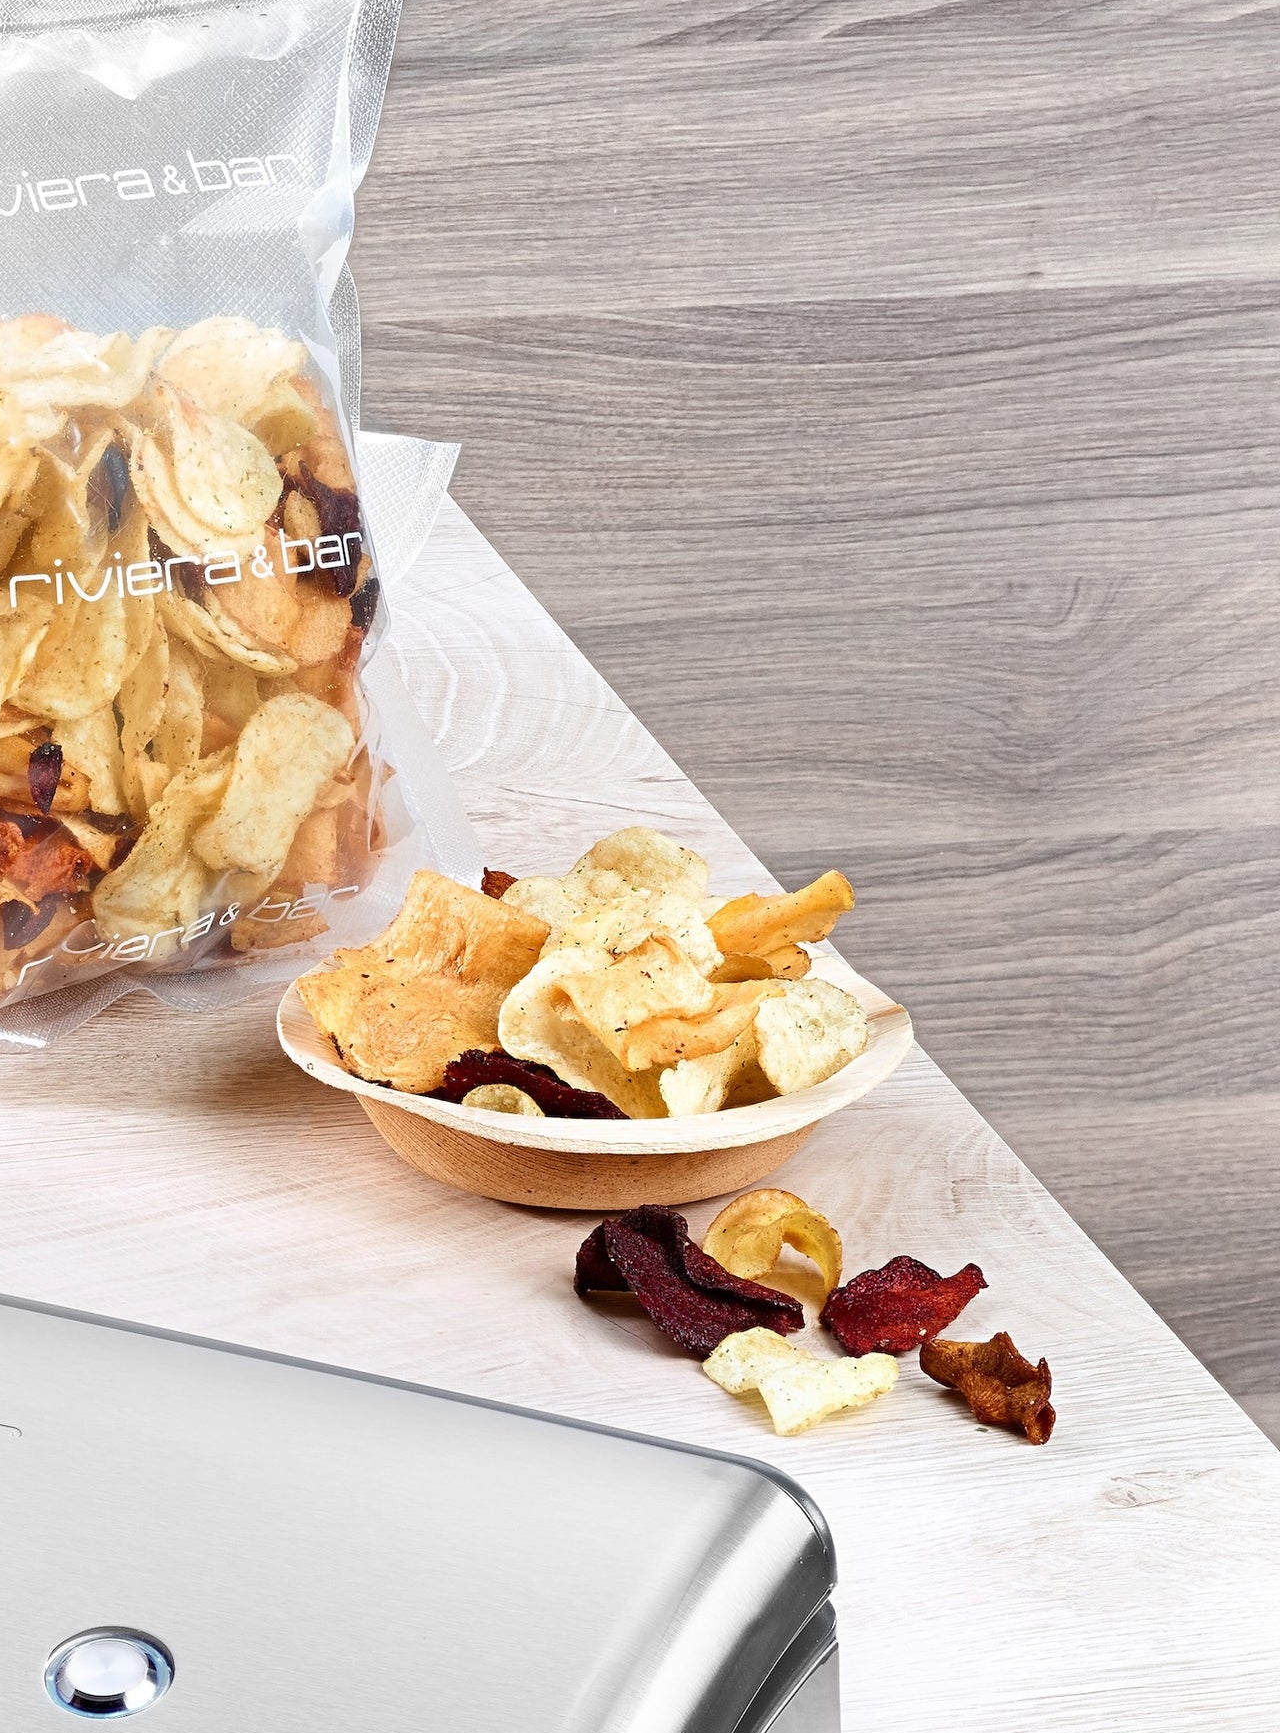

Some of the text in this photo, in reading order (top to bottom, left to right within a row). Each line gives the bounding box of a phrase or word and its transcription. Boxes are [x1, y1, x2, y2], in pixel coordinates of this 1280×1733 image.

[162, 164, 191, 196] &
[185, 149, 301, 193] bar
[8, 528, 363, 609] riviera & bar
